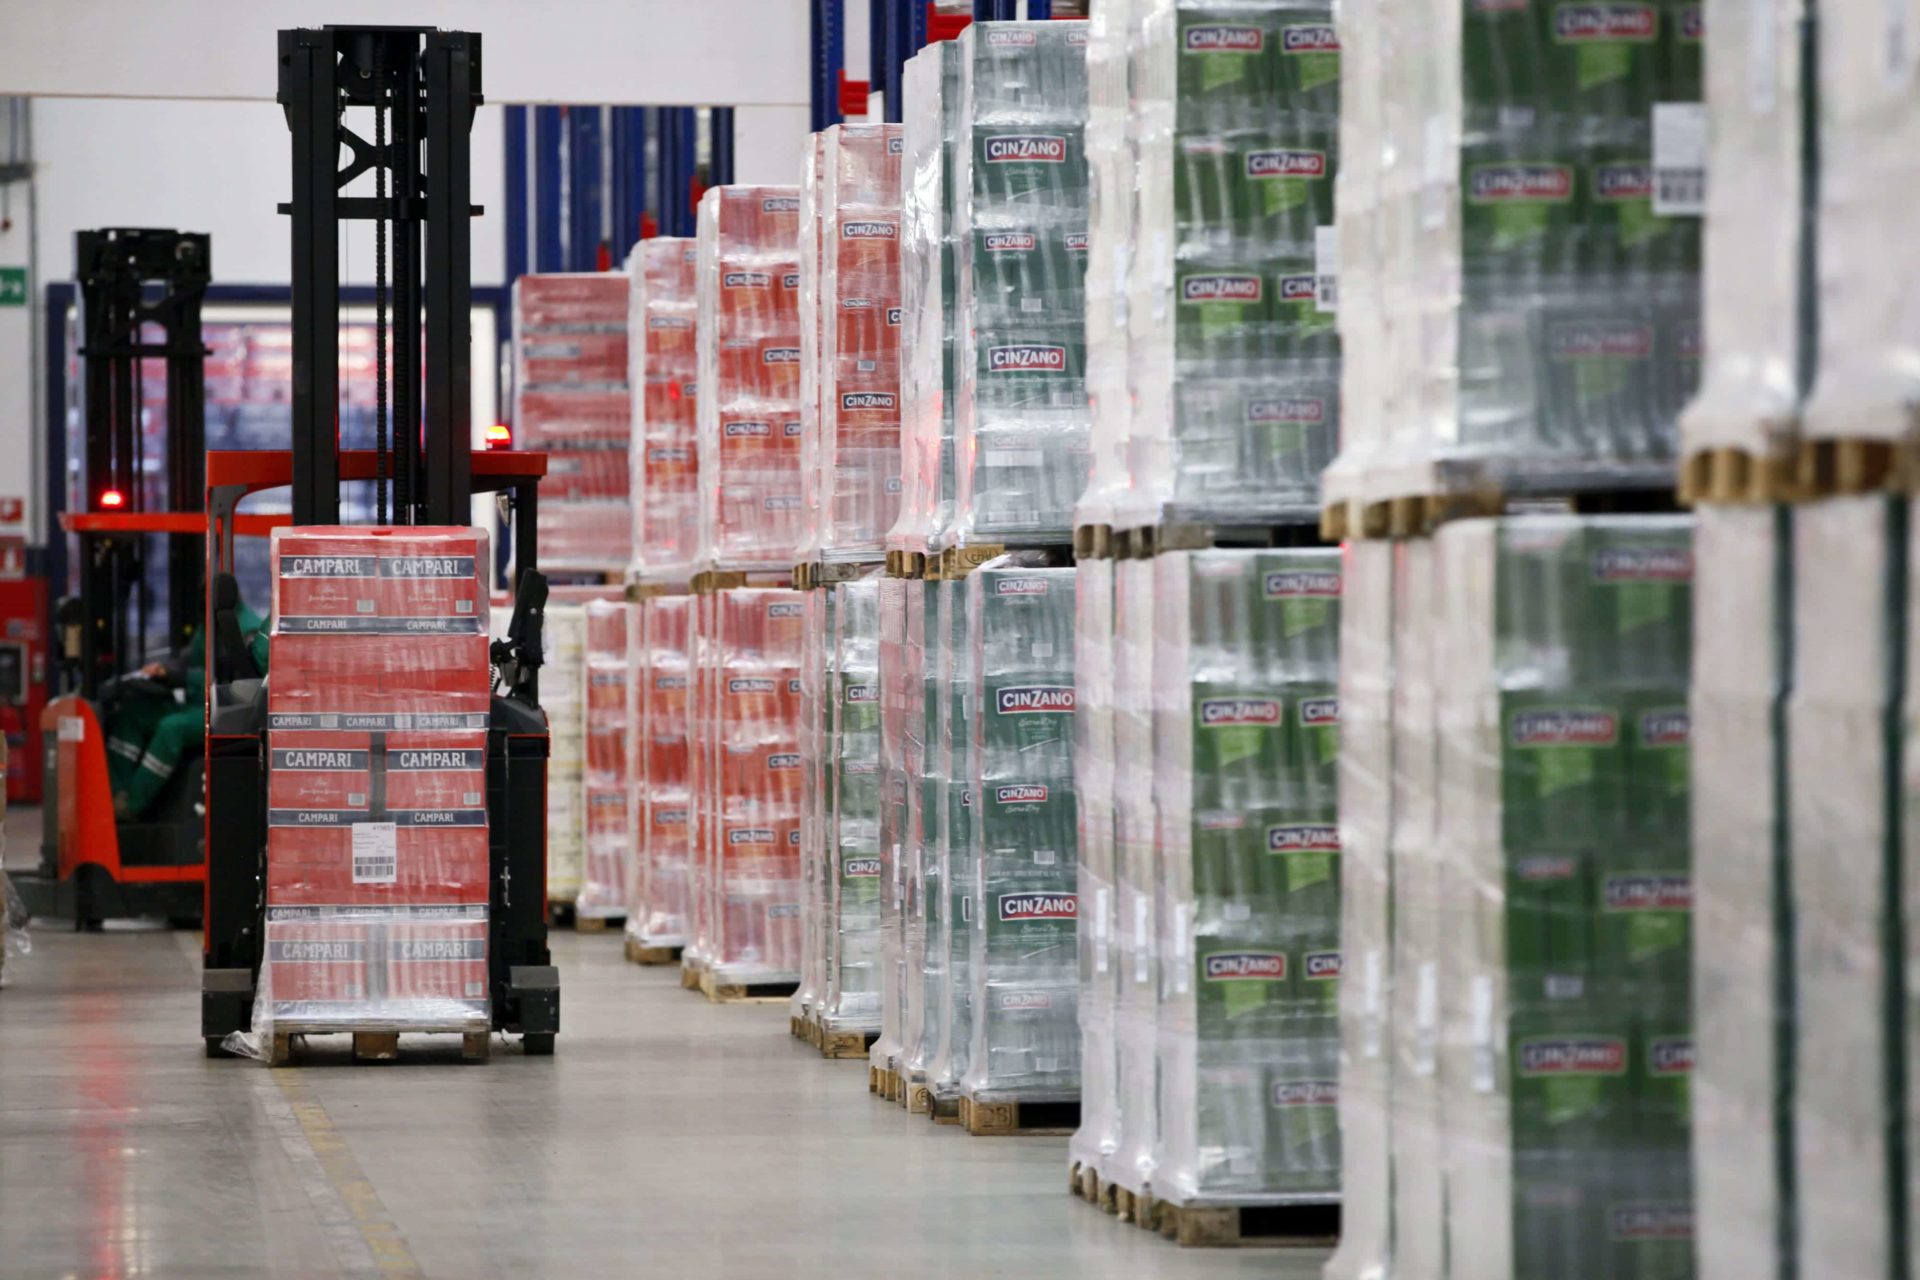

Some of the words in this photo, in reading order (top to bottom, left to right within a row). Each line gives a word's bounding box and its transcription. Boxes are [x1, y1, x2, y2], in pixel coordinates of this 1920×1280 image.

[1189, 28, 1258, 47] CINZANO
[990, 139, 1060, 157] CINZANO
[1251, 152, 1320, 172] CINZANO
[846, 224, 894, 237] CINZANO
[988, 235, 1032, 247] CINZANO
[1187, 278, 1256, 297] CINZANO
[993, 349, 1060, 366] CINZANO
[845, 395, 894, 407] CINZANO
[1251, 400, 1319, 419] CINZANO
[293, 558, 360, 575] CAMPARI
[392, 558, 459, 575] CAMPARI
[998, 580, 1047, 592] CINZANO
[1269, 574, 1338, 593] CINZANO
[307, 619, 347, 630] CAMPARI
[407, 620, 446, 630] CAMPARI
[1002, 690, 1073, 708] CINZANO
[1205, 702, 1276, 721] CINZANO
[272, 716, 312, 726] CAMPARI
[346, 717, 386, 727] CAMPARI
[419, 717, 459, 727] CAMPARI
[285, 752, 352, 768] CAMPARI
[400, 752, 467, 768] CAMPARI
[1000, 787, 1044, 799] CINZANO
[298, 813, 338, 823] CAMPARI
[414, 812, 454, 823] CAMPARI
[271, 908, 312, 919] CAMPARI
[1005, 897, 1076, 914] CINZANO
[282, 943, 348, 959] CAMPARI
[401, 942, 468, 959] CAMPARI
[1209, 956, 1281, 976] CINZANO
